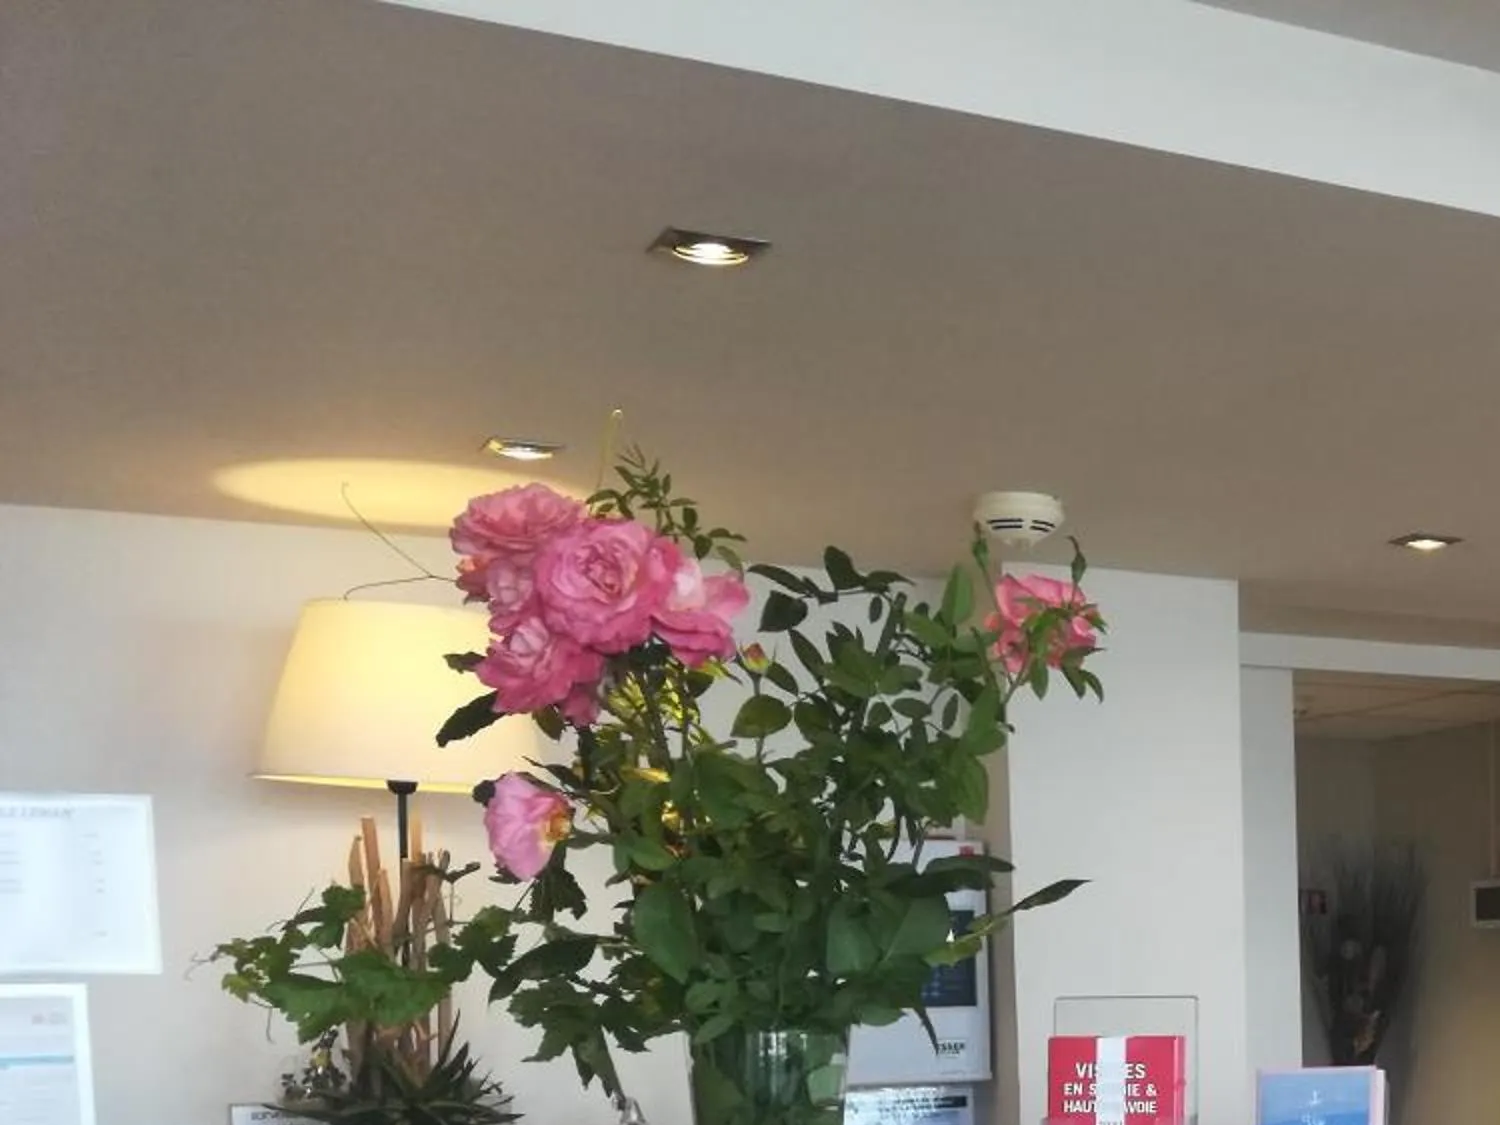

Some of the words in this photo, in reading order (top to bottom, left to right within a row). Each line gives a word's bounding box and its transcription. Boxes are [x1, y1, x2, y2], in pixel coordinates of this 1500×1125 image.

[1075, 1062, 1147, 1080] VIES
[1063, 1082, 1083, 1097] EN
[1145, 1082, 1158, 1097] &
